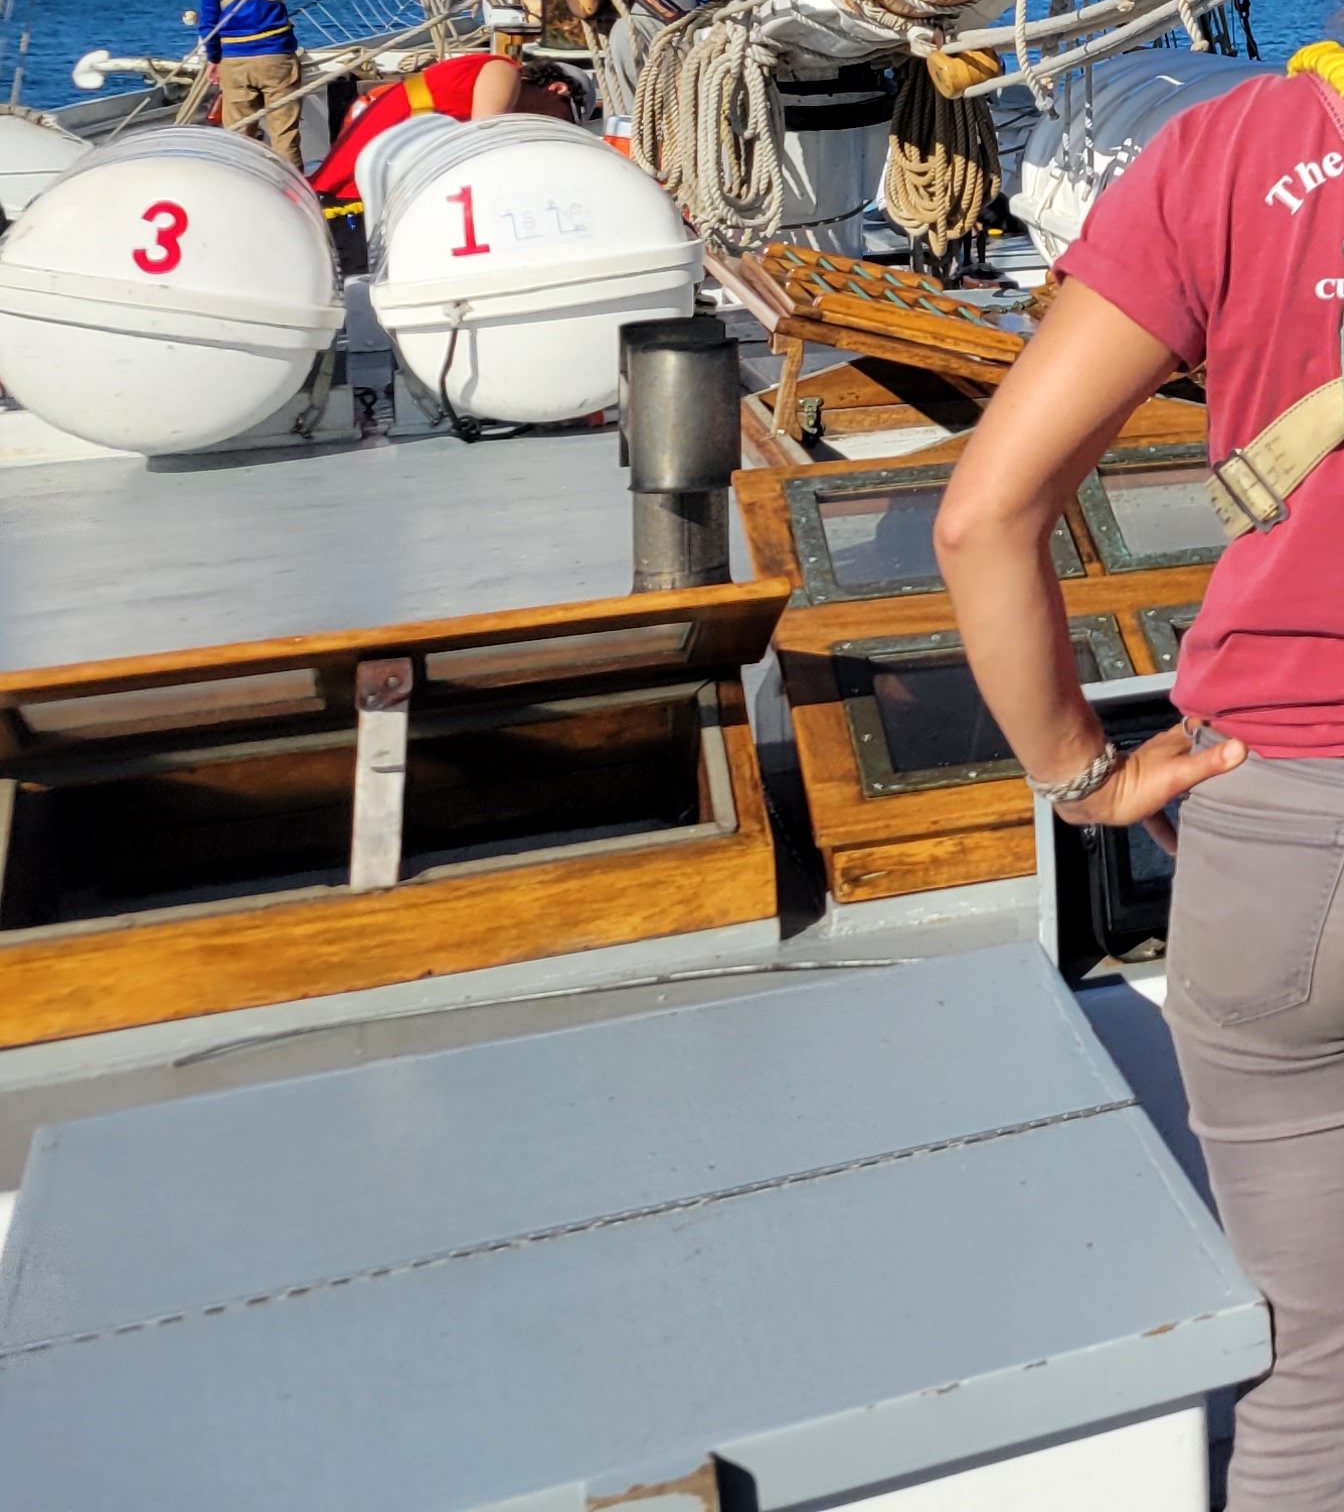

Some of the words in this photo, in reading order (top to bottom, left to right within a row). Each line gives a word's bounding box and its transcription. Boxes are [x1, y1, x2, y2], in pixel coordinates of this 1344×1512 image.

[1264, 150, 1344, 216] The
[132, 199, 189, 274] 3
[446, 184, 491, 257] 1
